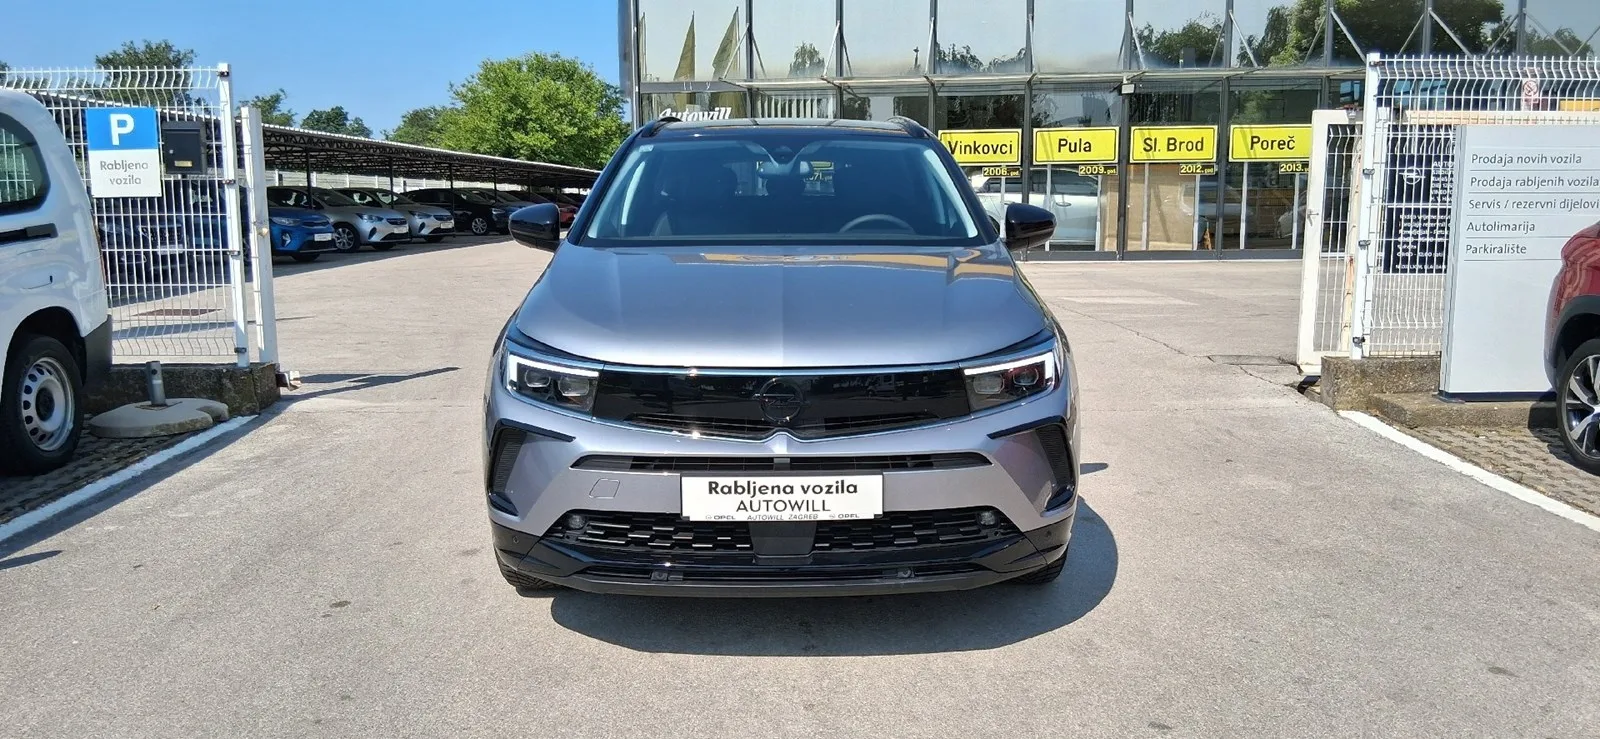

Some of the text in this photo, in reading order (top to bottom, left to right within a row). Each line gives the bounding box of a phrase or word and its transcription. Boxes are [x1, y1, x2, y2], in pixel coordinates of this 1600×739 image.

[659, 106, 732, 122] Autowill
[109, 113, 135, 146] P
[948, 140, 1013, 155] Vinkovci
[1058, 138, 1092, 153] Pula
[1143, 136, 1204, 153] Sl. Brod
[1250, 135, 1295, 151] Poreč
[100, 160, 149, 172] Rabljena
[1471, 153, 1582, 167] Prodaja novih vozila
[983, 167, 1010, 176] 2006.
[1079, 166, 1106, 175] 2009.
[1180, 165, 1204, 173] 2012.
[1280, 163, 1304, 172] 2013.
[109, 175, 142, 185] vozila
[1470, 176, 1599, 190] Prodaja rabljenih vozila
[1468, 198, 1599, 212] Servis / rezervni dijelovi
[1466, 221, 1536, 234] Autolimarija
[1466, 243, 1527, 254] Parkiralište
[708, 479, 858, 498] Rabljena vozila
[736, 499, 831, 512] AUTOWILL
